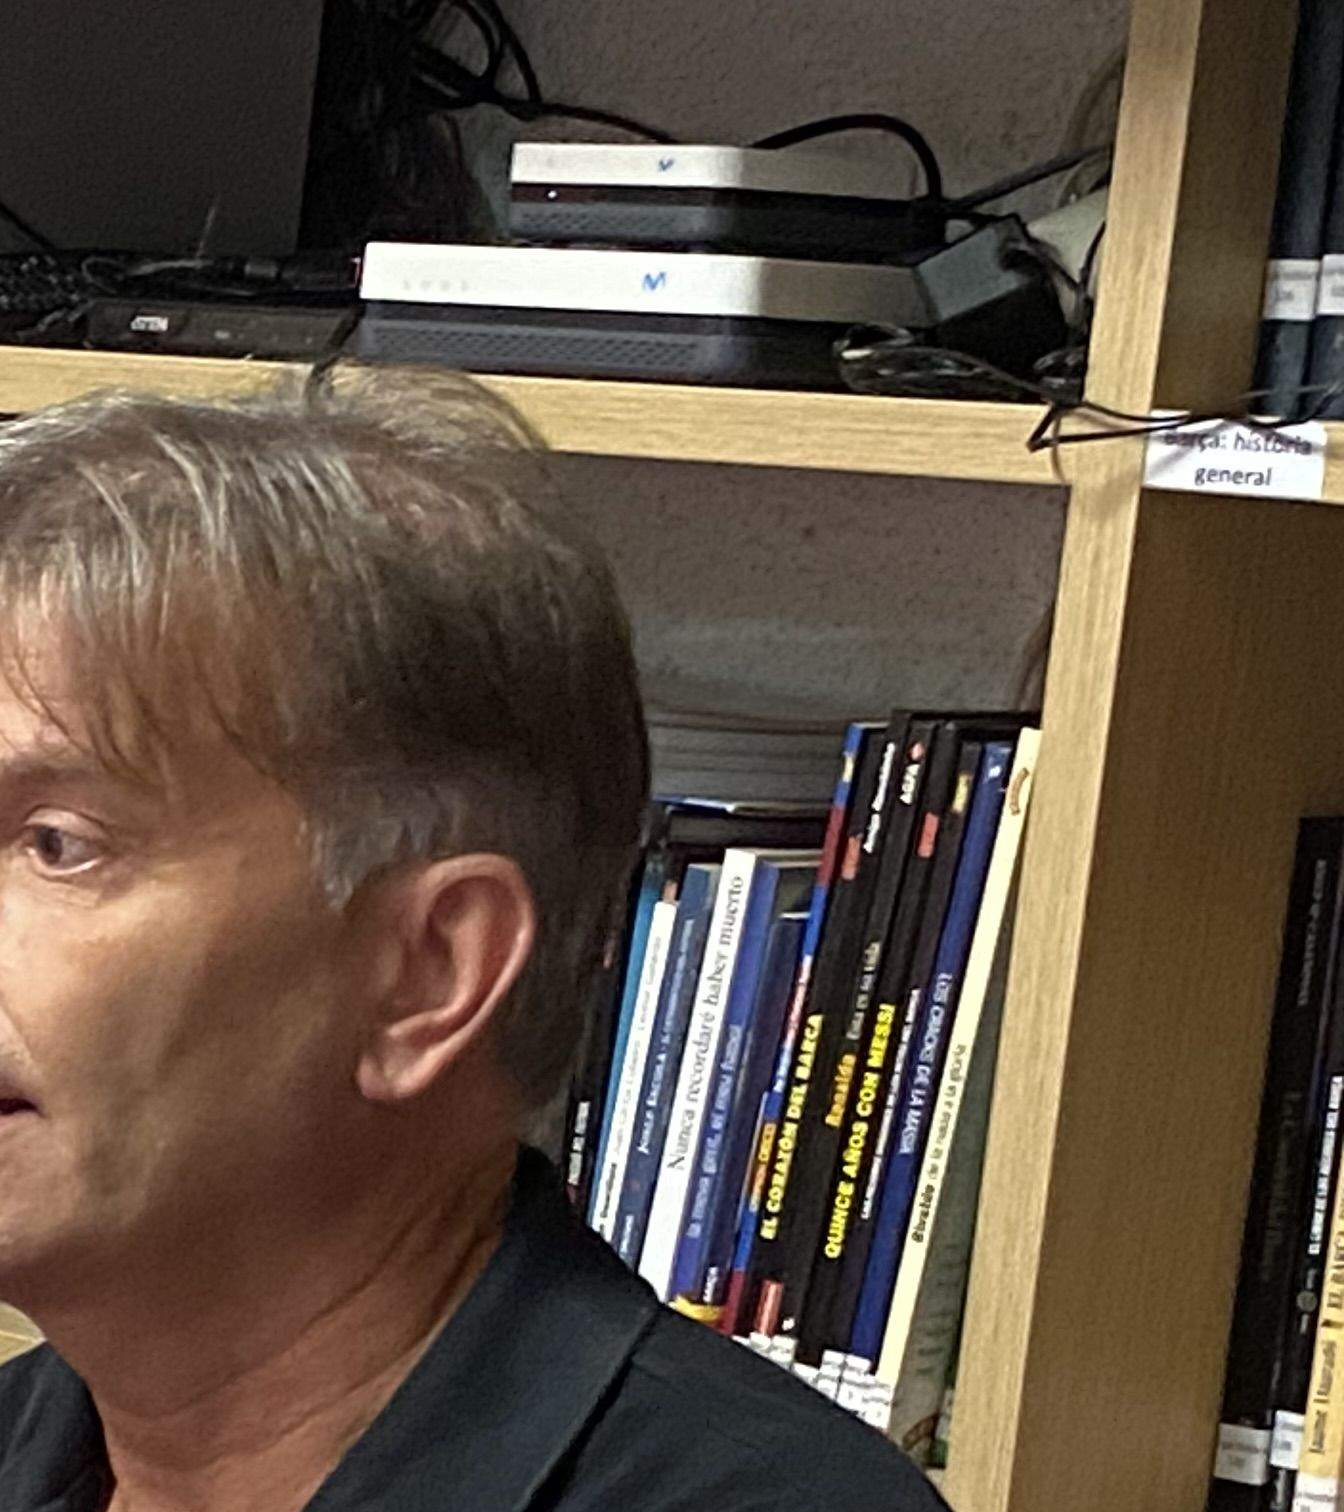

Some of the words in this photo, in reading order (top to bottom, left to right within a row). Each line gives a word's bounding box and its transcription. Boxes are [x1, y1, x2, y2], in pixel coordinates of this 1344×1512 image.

[1194, 467, 1273, 486] general
[667, 1110, 698, 1170] Nunca
[683, 1012, 717, 1106] recordaré
[707, 948, 730, 1009] haber
[719, 874, 744, 945] muerto
[867, 1003, 895, 1068] MESSI
[786, 1083, 808, 1118] DEL
[856, 1072, 880, 1117] CON
[766, 1122, 798, 1213] CORAZÓN
[842, 1121, 869, 1178] AÑOS
[760, 1217, 778, 1240] EL
[824, 1181, 854, 1258] QUINCE
